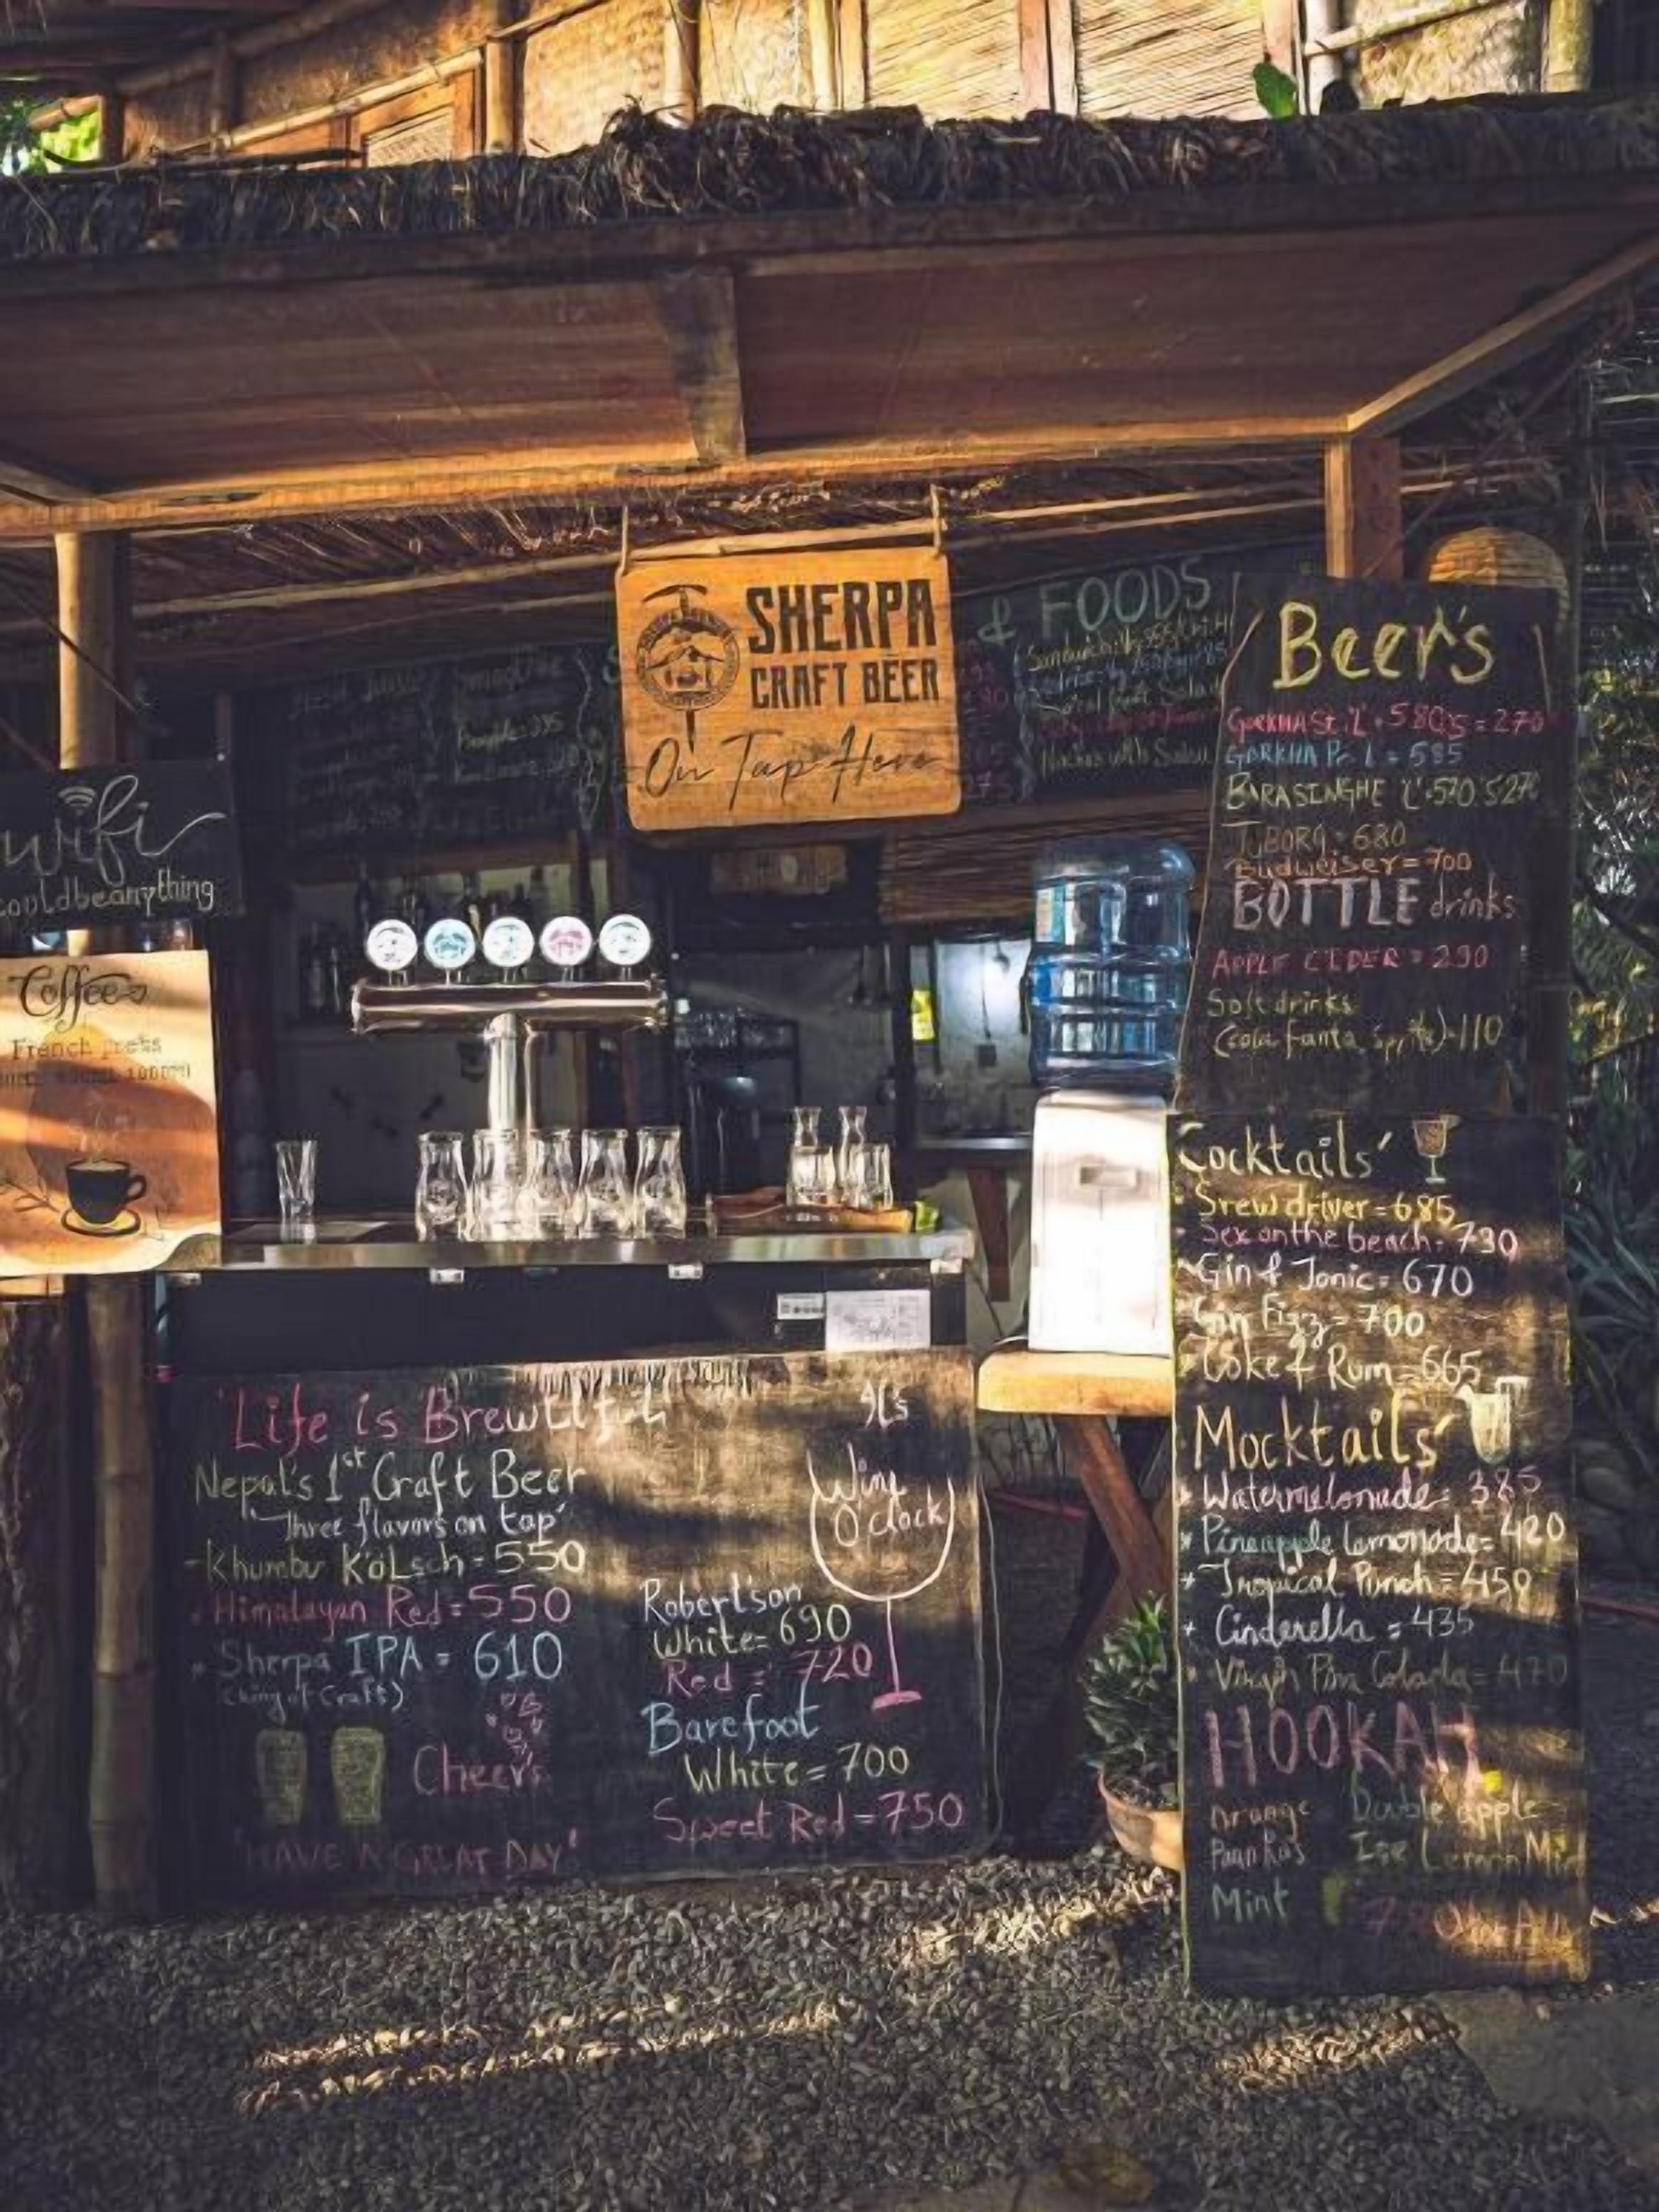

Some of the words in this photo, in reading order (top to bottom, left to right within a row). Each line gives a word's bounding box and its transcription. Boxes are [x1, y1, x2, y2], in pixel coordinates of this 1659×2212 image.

[746, 579, 936, 654] SHERPA
[1039, 554, 1210, 639] FOODS
[1272, 602, 1496, 690] Beer's
[750, 662, 848, 709] CRAFT
[862, 658, 939, 704] BEER
[721, 728, 827, 811] Tap
[1233, 875, 1421, 931] BOTTLE
[1429, 873, 1514, 922] drinks
[9, 964, 148, 1033] Coffee
[1402, 1257, 1473, 1298] 670
[1357, 1303, 1425, 1338] 700
[195, 1453, 315, 1518] Nepal's
[372, 1447, 472, 1514] Craft
[491, 1447, 588, 1499] Beer
[495, 1539, 586, 1574] 550
[214, 1590, 367, 1642] Himalayan
[387, 1586, 441, 1629] Red
[468, 1583, 572, 1624] 550
[779, 1604, 852, 1645] 690
[1215, 1601, 1377, 1649] Cinderella
[1411, 1604, 1475, 1641] 435
[345, 1631, 424, 1678] IPA
[473, 1629, 564, 1680] 610
[665, 1658, 734, 1698] Red
[793, 1643, 873, 1685] 720
[640, 1683, 821, 1756] Barefoot
[683, 1747, 799, 1795] White
[837, 1742, 910, 1783] 700
[1205, 1699, 1486, 1796] HOOKAH
[783, 1793, 845, 1843] Red
[878, 1790, 965, 1835] 750
[1210, 1875, 1290, 1928] Mint
